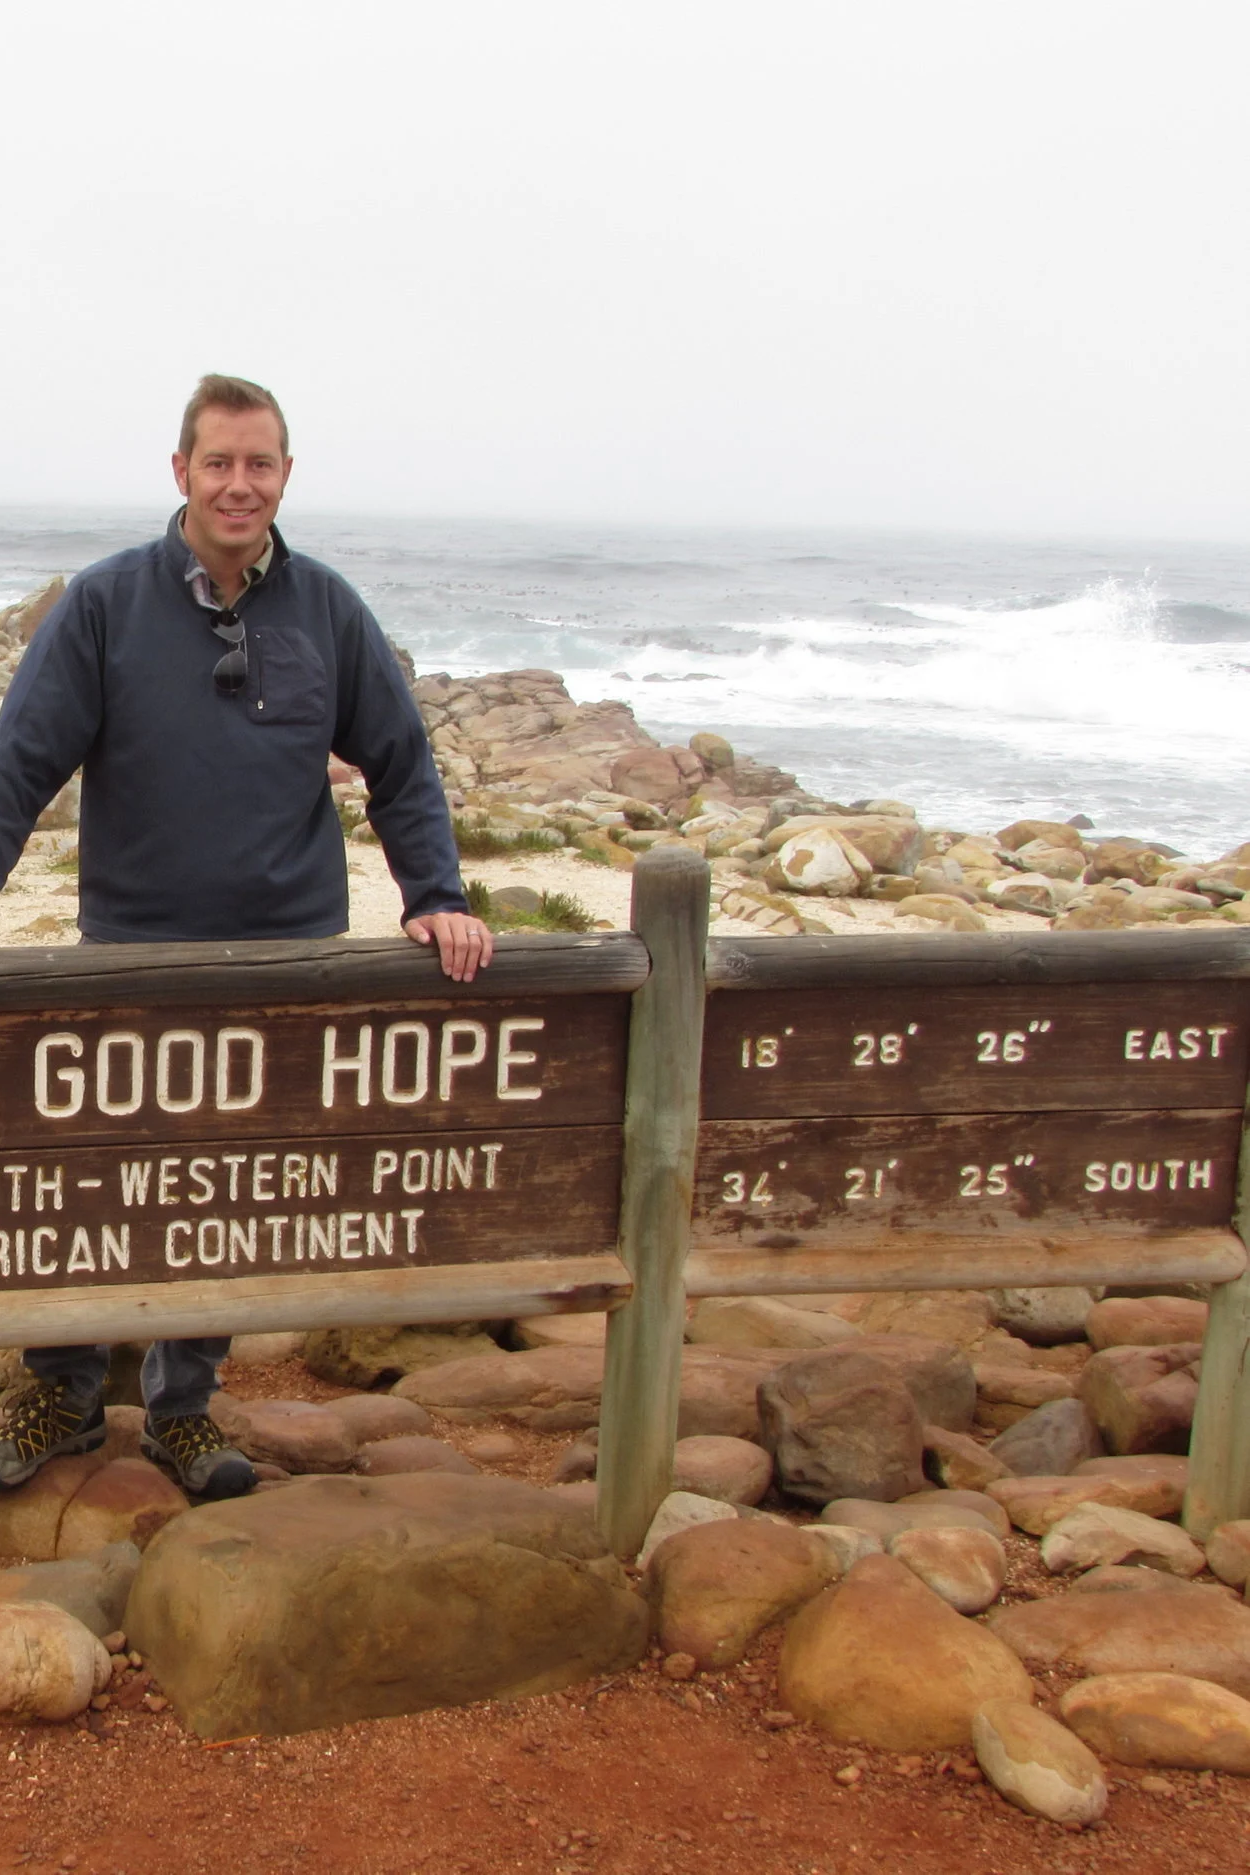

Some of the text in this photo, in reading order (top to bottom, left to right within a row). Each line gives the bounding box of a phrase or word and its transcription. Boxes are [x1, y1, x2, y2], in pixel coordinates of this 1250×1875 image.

[34, 1026, 265, 1119] GOOD
[321, 1018, 545, 1109] HOPE
[1124, 1027, 1229, 1060] EAST
[372, 1143, 504, 1195] POINT
[1084, 1159, 1212, 1193] SOUTH
[164, 1208, 425, 1268] CONTINENT
